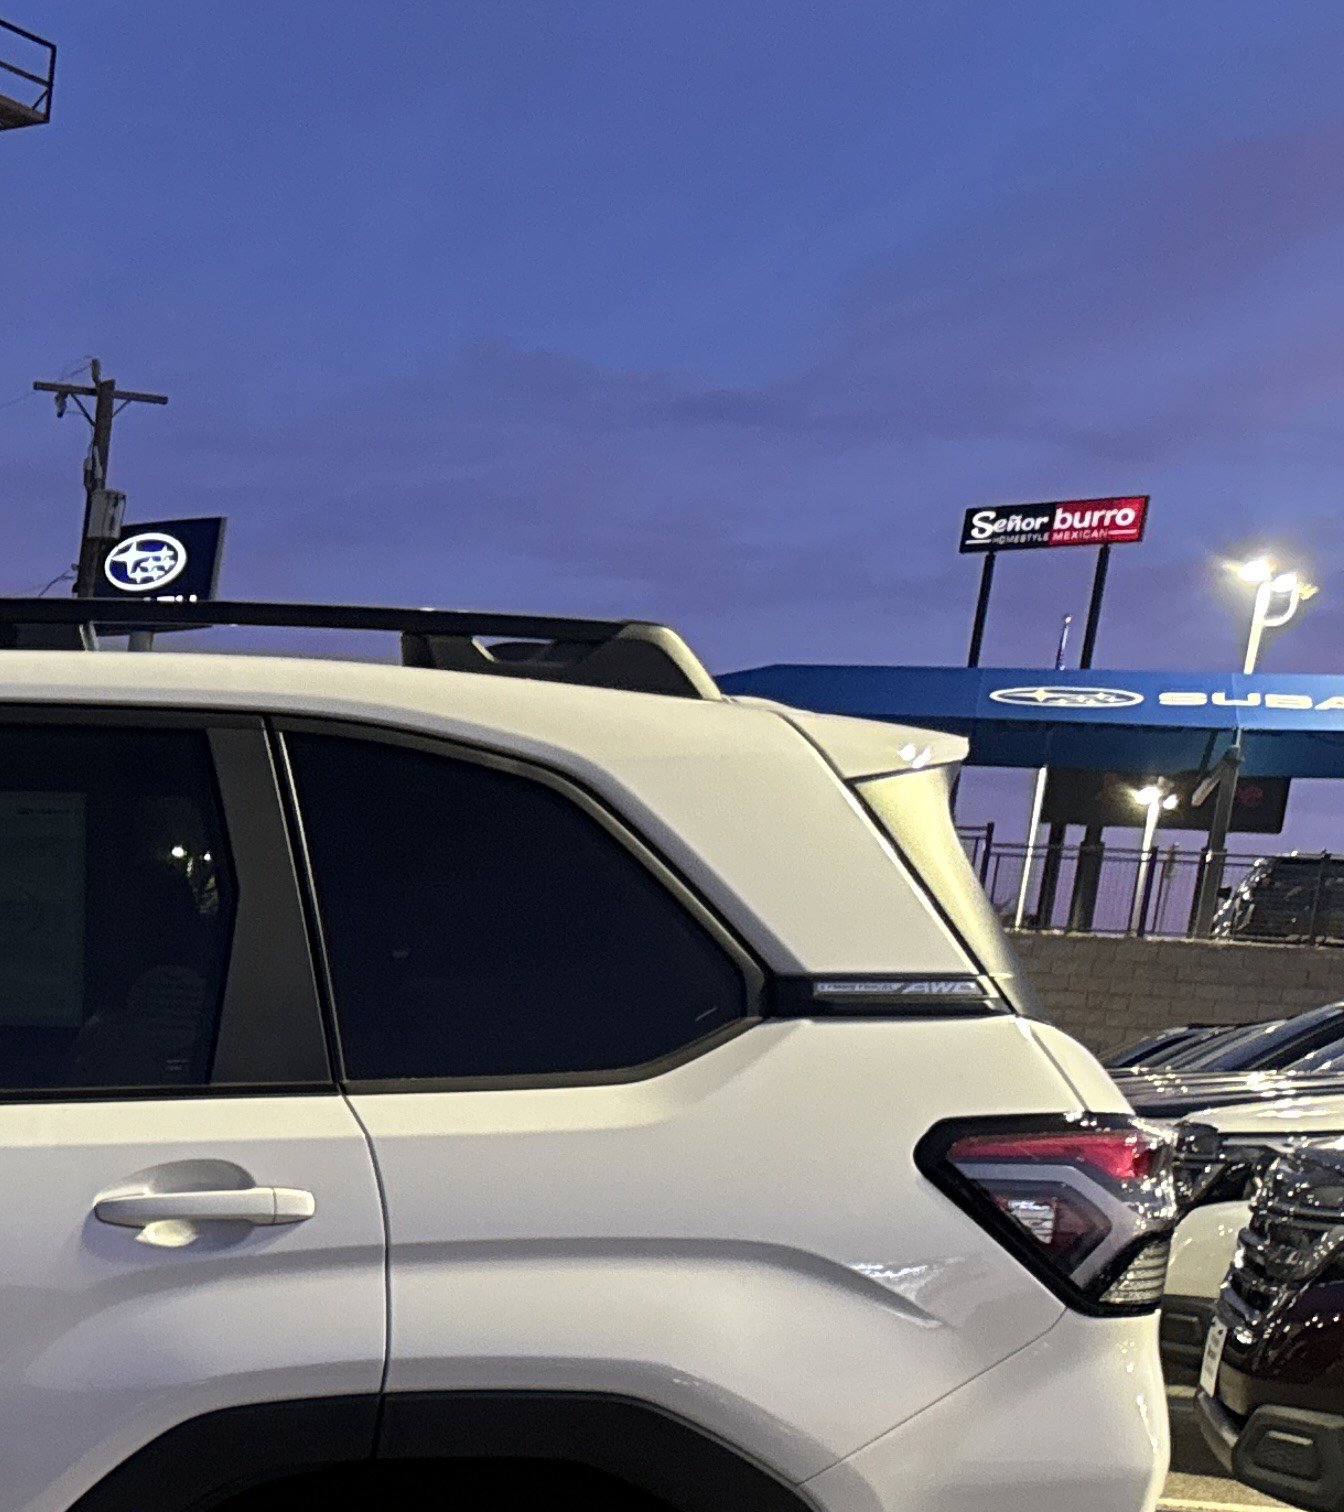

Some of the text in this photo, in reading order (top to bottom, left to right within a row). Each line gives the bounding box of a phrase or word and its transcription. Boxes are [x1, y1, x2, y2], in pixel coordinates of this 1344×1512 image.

[971, 507, 1136, 539] Señor burro
[992, 529, 1109, 545] HOMESTYLE MEXICAN
[901, 981, 984, 994] AWD
